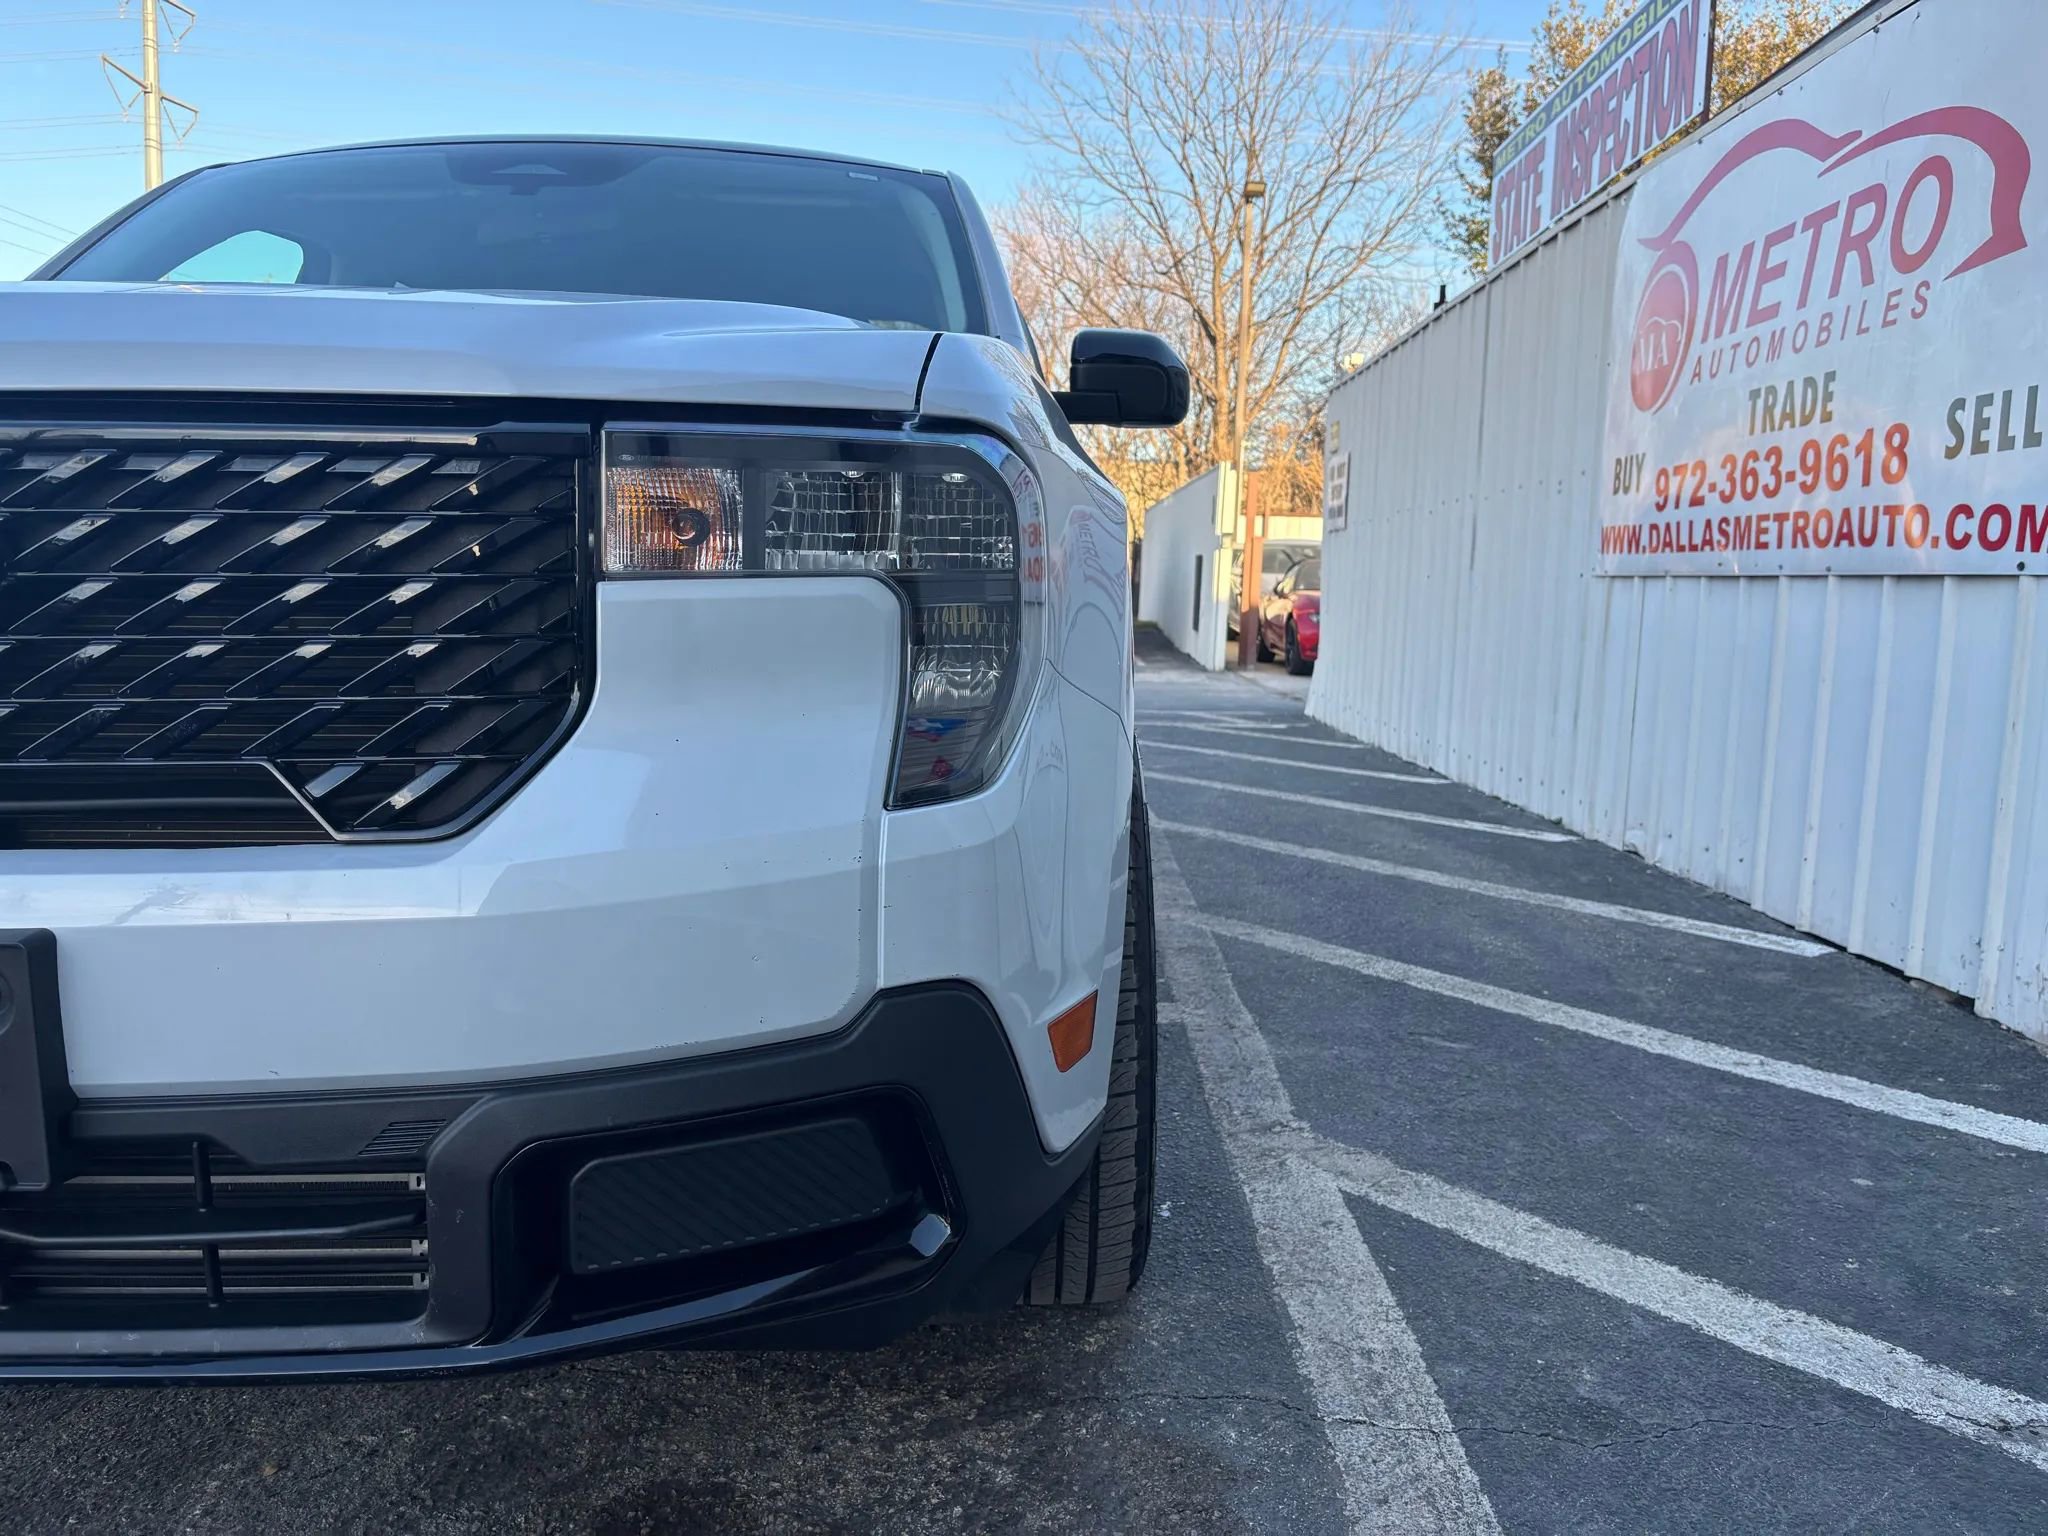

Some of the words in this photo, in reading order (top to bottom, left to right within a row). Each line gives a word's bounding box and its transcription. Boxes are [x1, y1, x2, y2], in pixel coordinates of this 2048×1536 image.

[1494, 111, 1547, 168] METRO
[1550, 0, 1683, 115] AUTOMOBIL
[1493, 136, 1547, 265] STATE
[1550, 0, 1699, 221] INSPECTION
[1700, 155, 1954, 344] METRO
[1689, 280, 1931, 386] AUTOMOBILES
[1748, 370, 1837, 436] TRADE
[1943, 384, 2043, 460] SELL
[1612, 453, 1646, 496] BUY
[1654, 423, 1910, 513] 972-363-9618
[1600, 503, 2048, 556] WWW.DALLASMETROAUTO.COM
